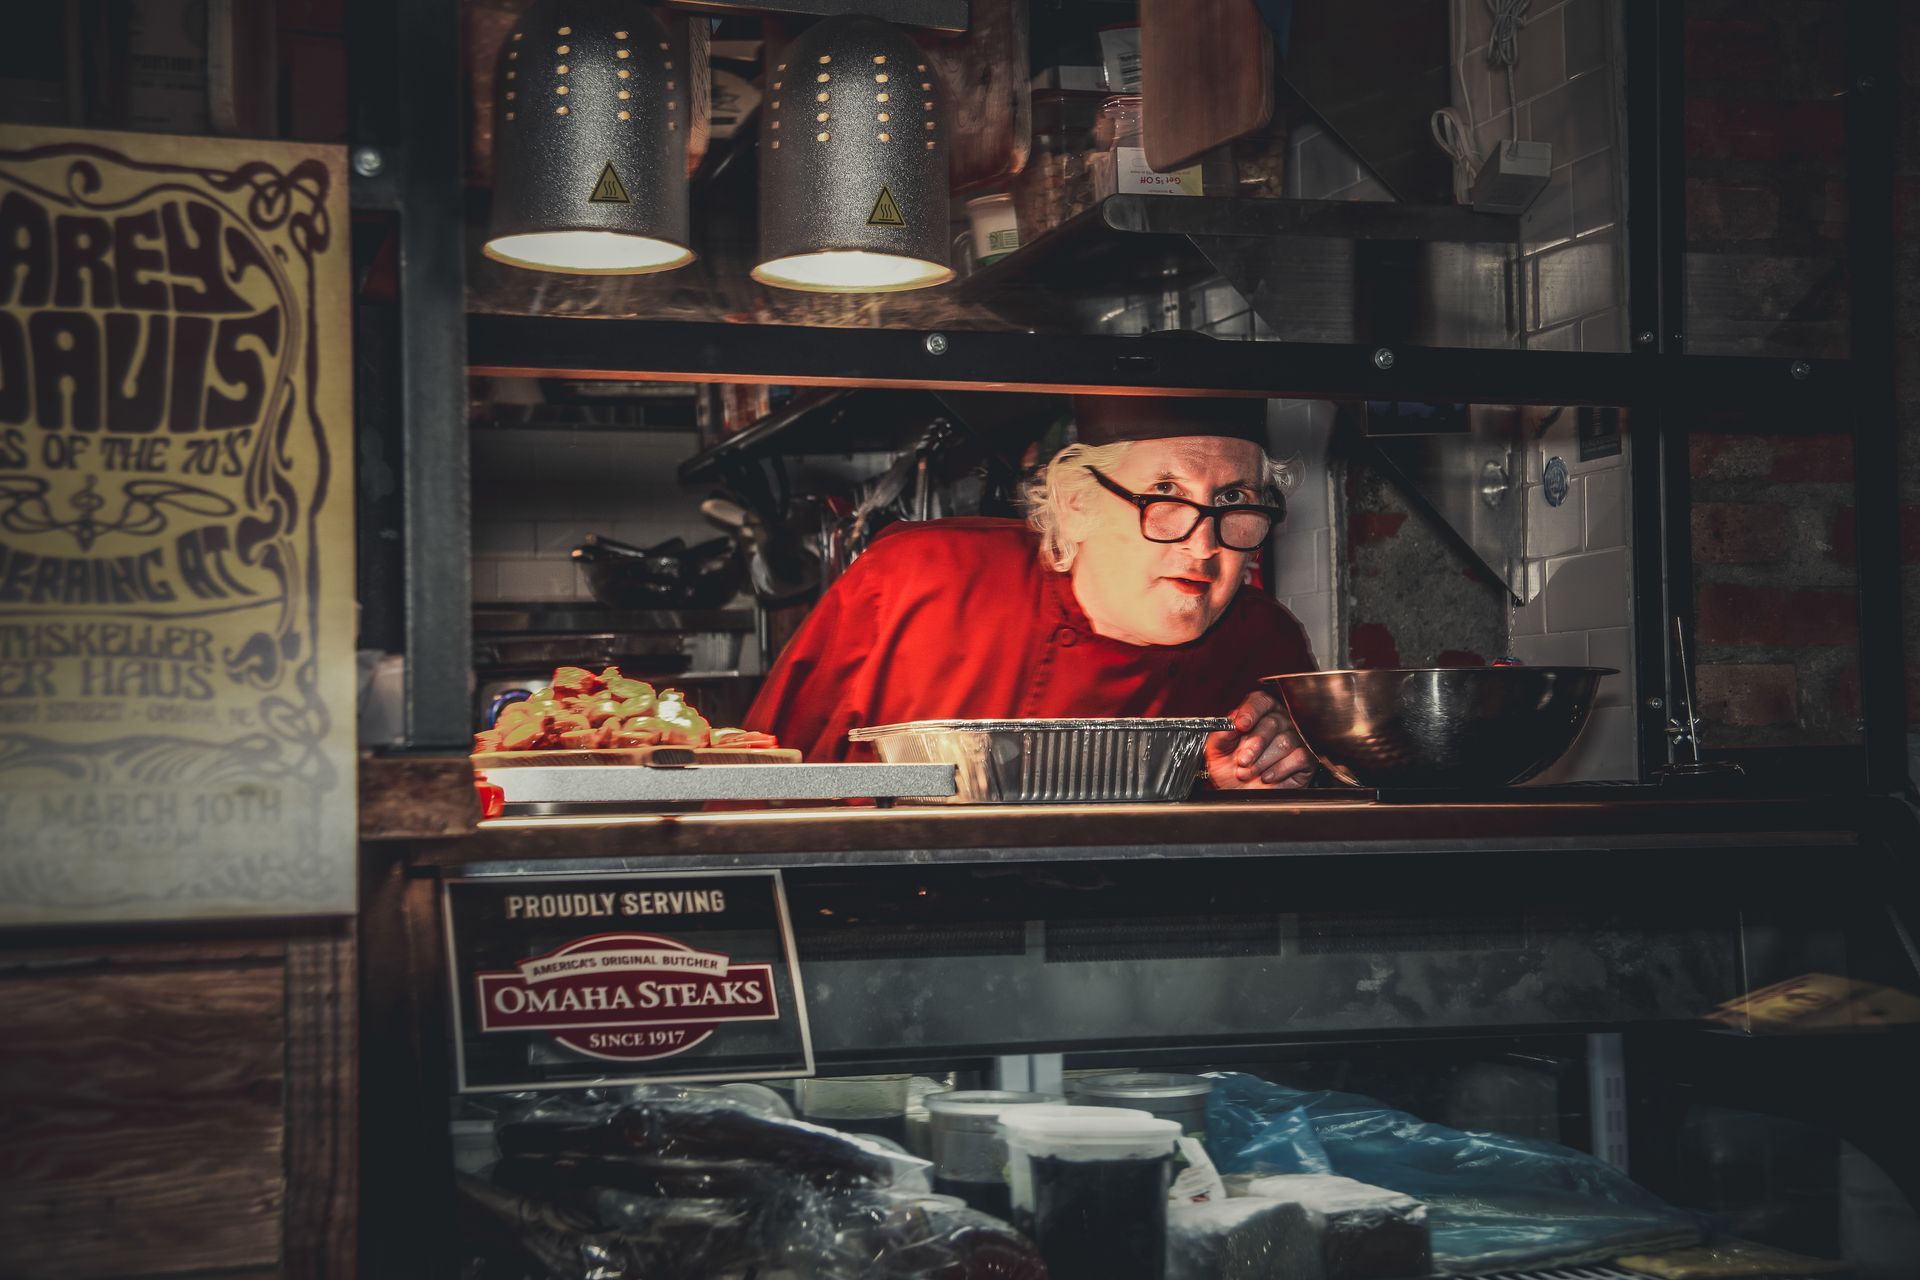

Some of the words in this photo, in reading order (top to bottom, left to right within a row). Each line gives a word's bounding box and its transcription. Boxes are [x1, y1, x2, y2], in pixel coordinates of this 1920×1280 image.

[1140, 176, 1153, 184] Off
[1166, 176, 1181, 184] Get
[41, 433, 90, 471] OF
[100, 436, 171, 473] THE
[175, 526, 259, 600] AT
[80, 659, 215, 701] HAUS
[41, 791, 177, 828] MARCH
[507, 892, 616, 919] PROUDLY
[621, 889, 726, 916] SERVING
[533, 957, 597, 977] AMERICA'S
[602, 955, 657, 967] ORIGINAL
[662, 955, 718, 970] BUTCHER
[494, 985, 635, 1014] OMAHA
[638, 980, 763, 1009] STEAKS
[589, 1032, 645, 1048] SINCE
[648, 1030, 686, 1047] 1917
